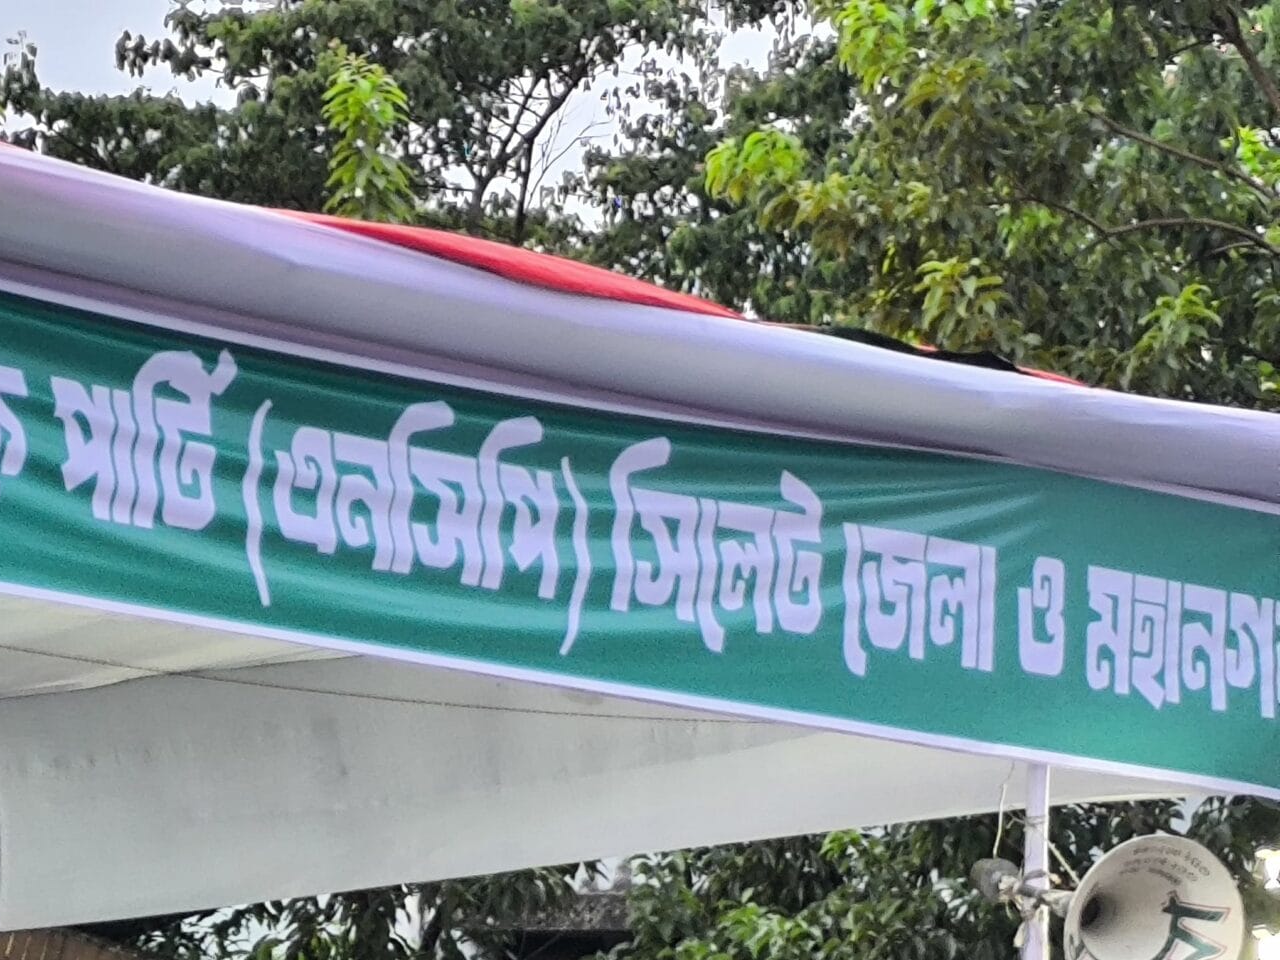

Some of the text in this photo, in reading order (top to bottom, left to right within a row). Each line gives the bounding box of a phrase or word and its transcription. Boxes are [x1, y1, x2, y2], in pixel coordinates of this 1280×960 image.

[51, 348, 238, 530] পার্টি
[242, 399, 591, 656] (এনসিপি)
[610, 436, 822, 653] সিলেট
[843, 522, 997, 677] জেলা
[1018, 556, 1066, 677] ও
[1086, 565, 1280, 720] মহানগ
